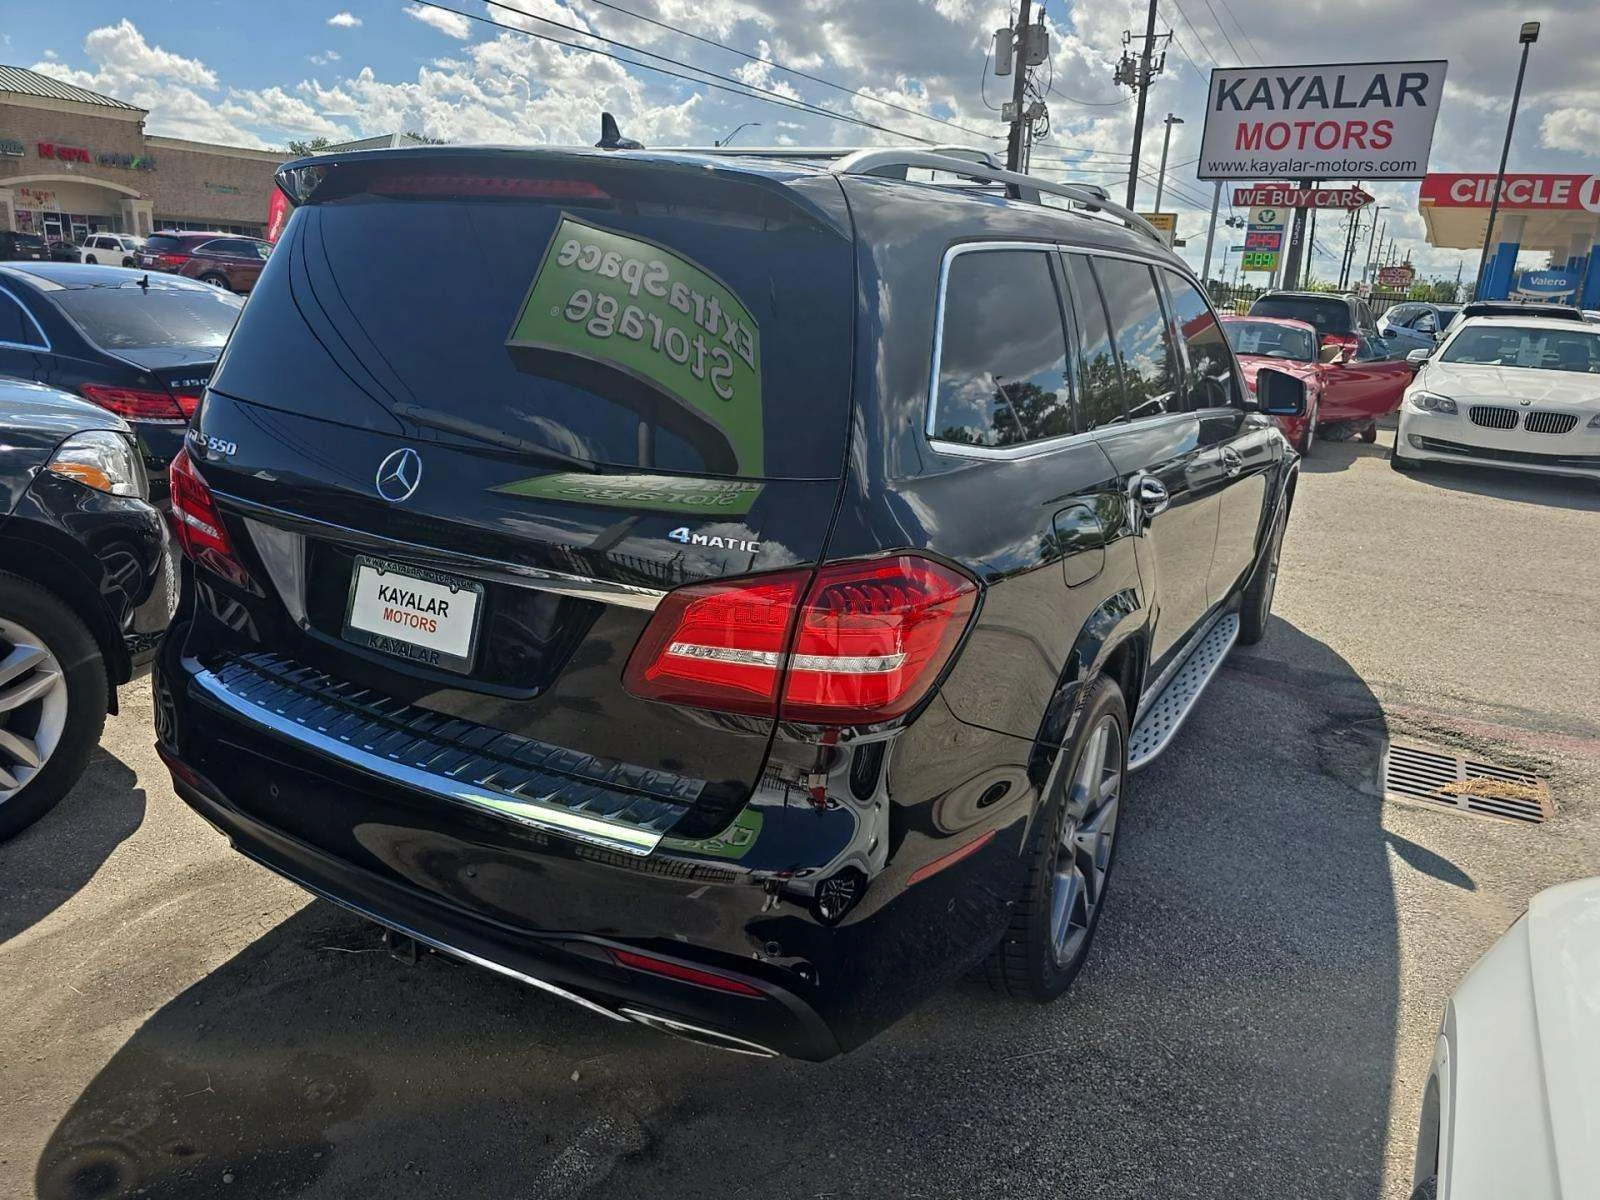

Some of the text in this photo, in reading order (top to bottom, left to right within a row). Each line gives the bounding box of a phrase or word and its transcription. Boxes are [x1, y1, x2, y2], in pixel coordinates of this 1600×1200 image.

[1215, 72, 1430, 112] KAYALAR
[1235, 119, 1394, 150] MOTORS
[1207, 158, 1417, 176] www.kayalar-motors.com
[1237, 190, 1365, 206] WE BUY CARS
[1450, 178, 1572, 204] CIRCLE
[1530, 276, 1567, 287] Valero
[667, 526, 762, 553] 4MATIC
[377, 584, 450, 618] KAYALAR
[382, 606, 438, 634] MOTORS
[367, 633, 441, 665] KAYALAR
